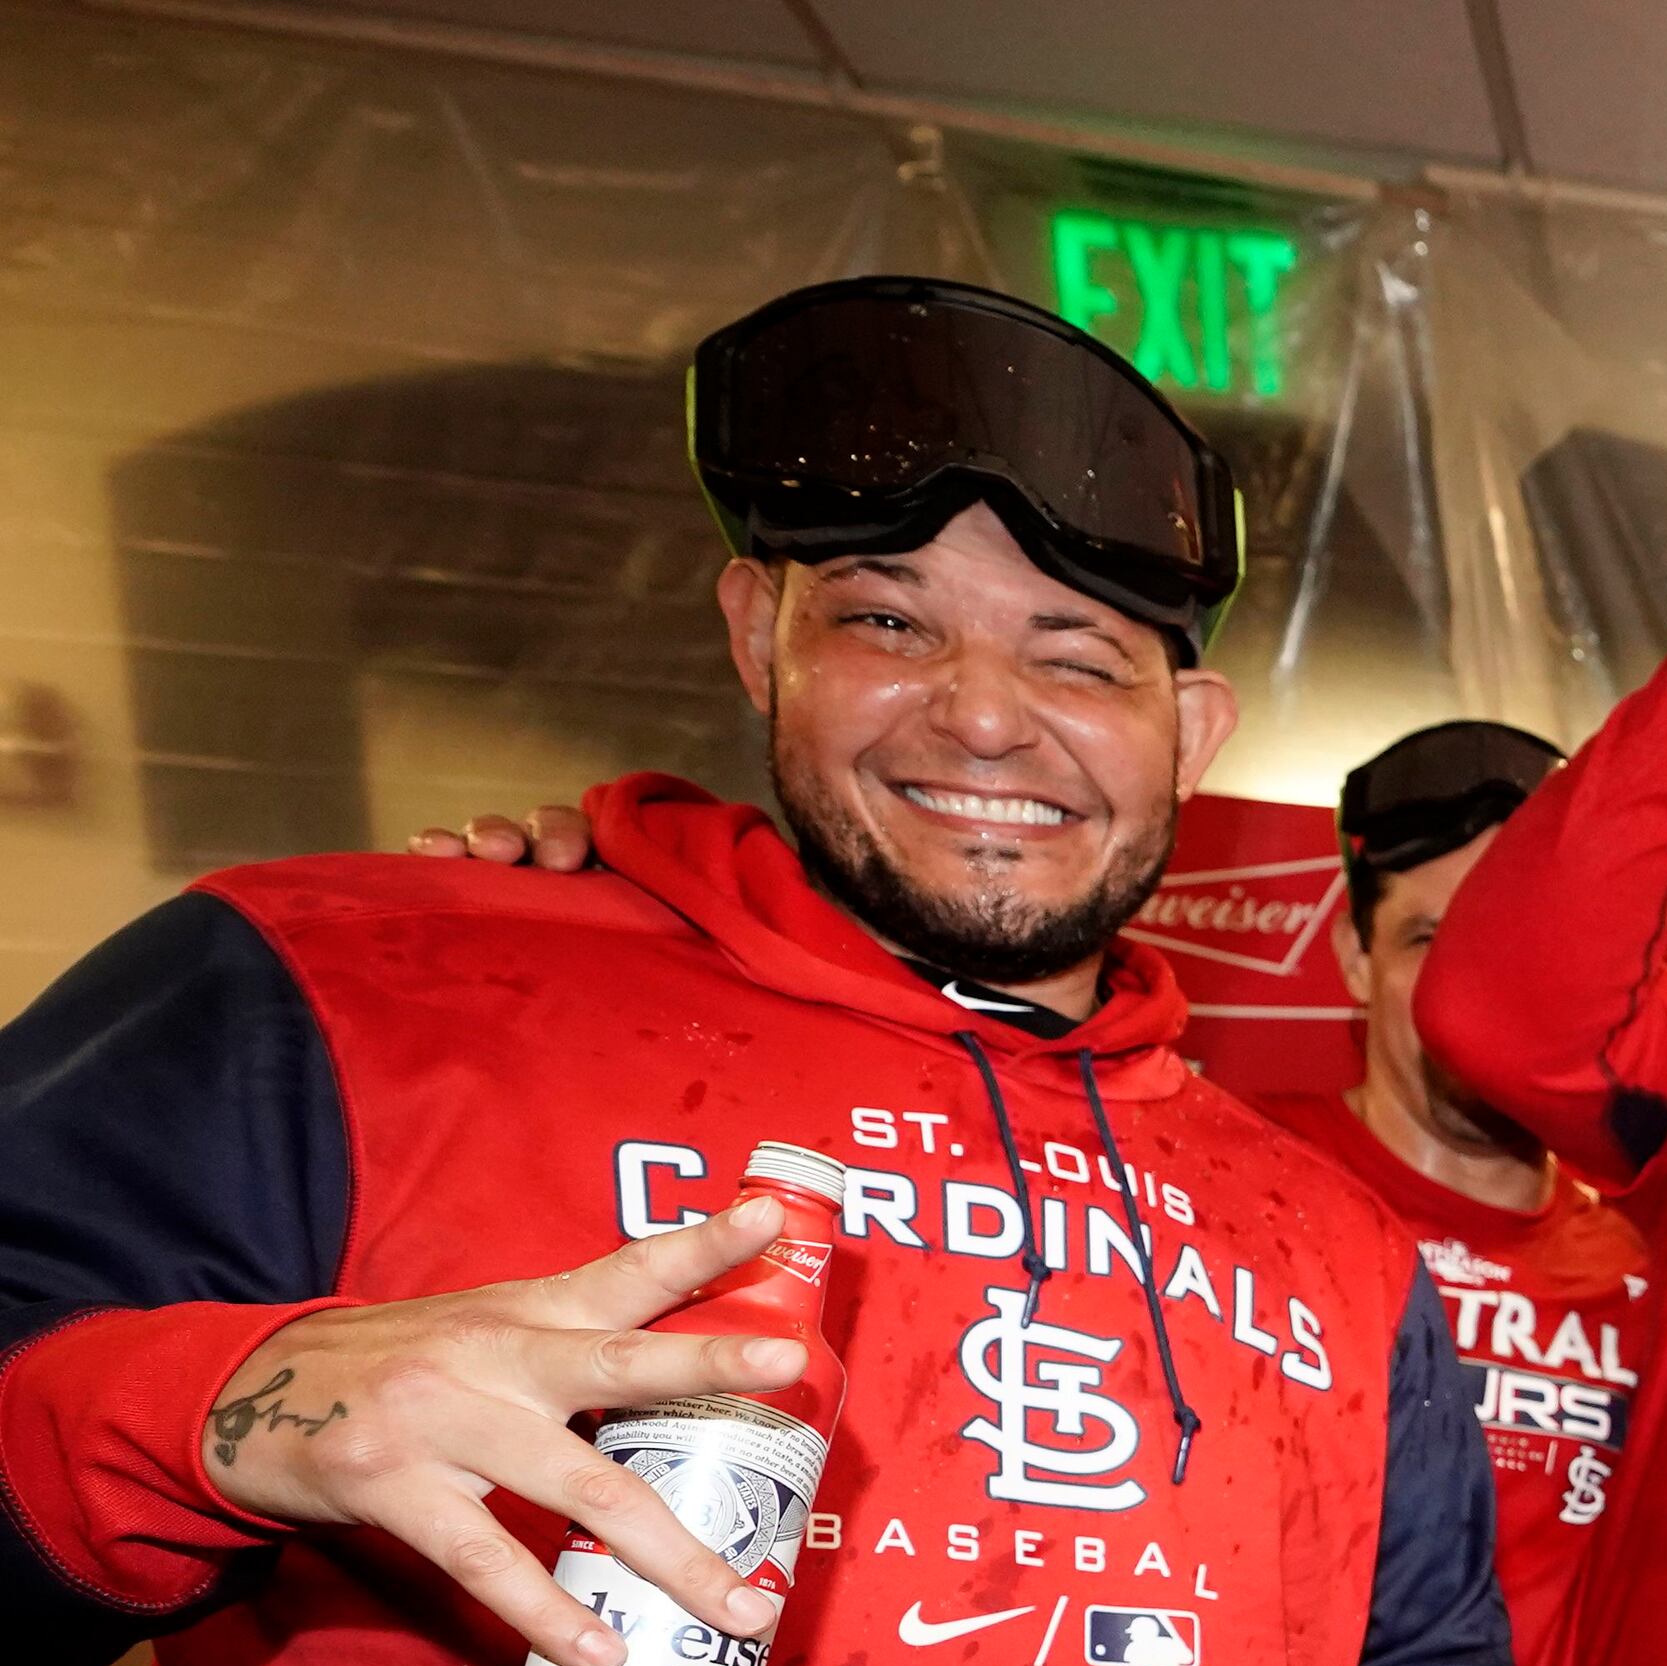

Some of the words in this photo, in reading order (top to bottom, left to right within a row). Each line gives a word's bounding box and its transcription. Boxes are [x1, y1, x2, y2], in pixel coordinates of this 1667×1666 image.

[1053, 213, 1297, 396] EXIT
[1138, 888, 1312, 934] weiser
[850, 1107, 965, 1158] ST.
[614, 1140, 1334, 1393] CRDINALS
[765, 1244, 824, 1271] weiser
[1441, 1287, 1638, 1387] TRAL
[752, 1416, 780, 1431] know
[571, 1539, 597, 1551] SINCE
